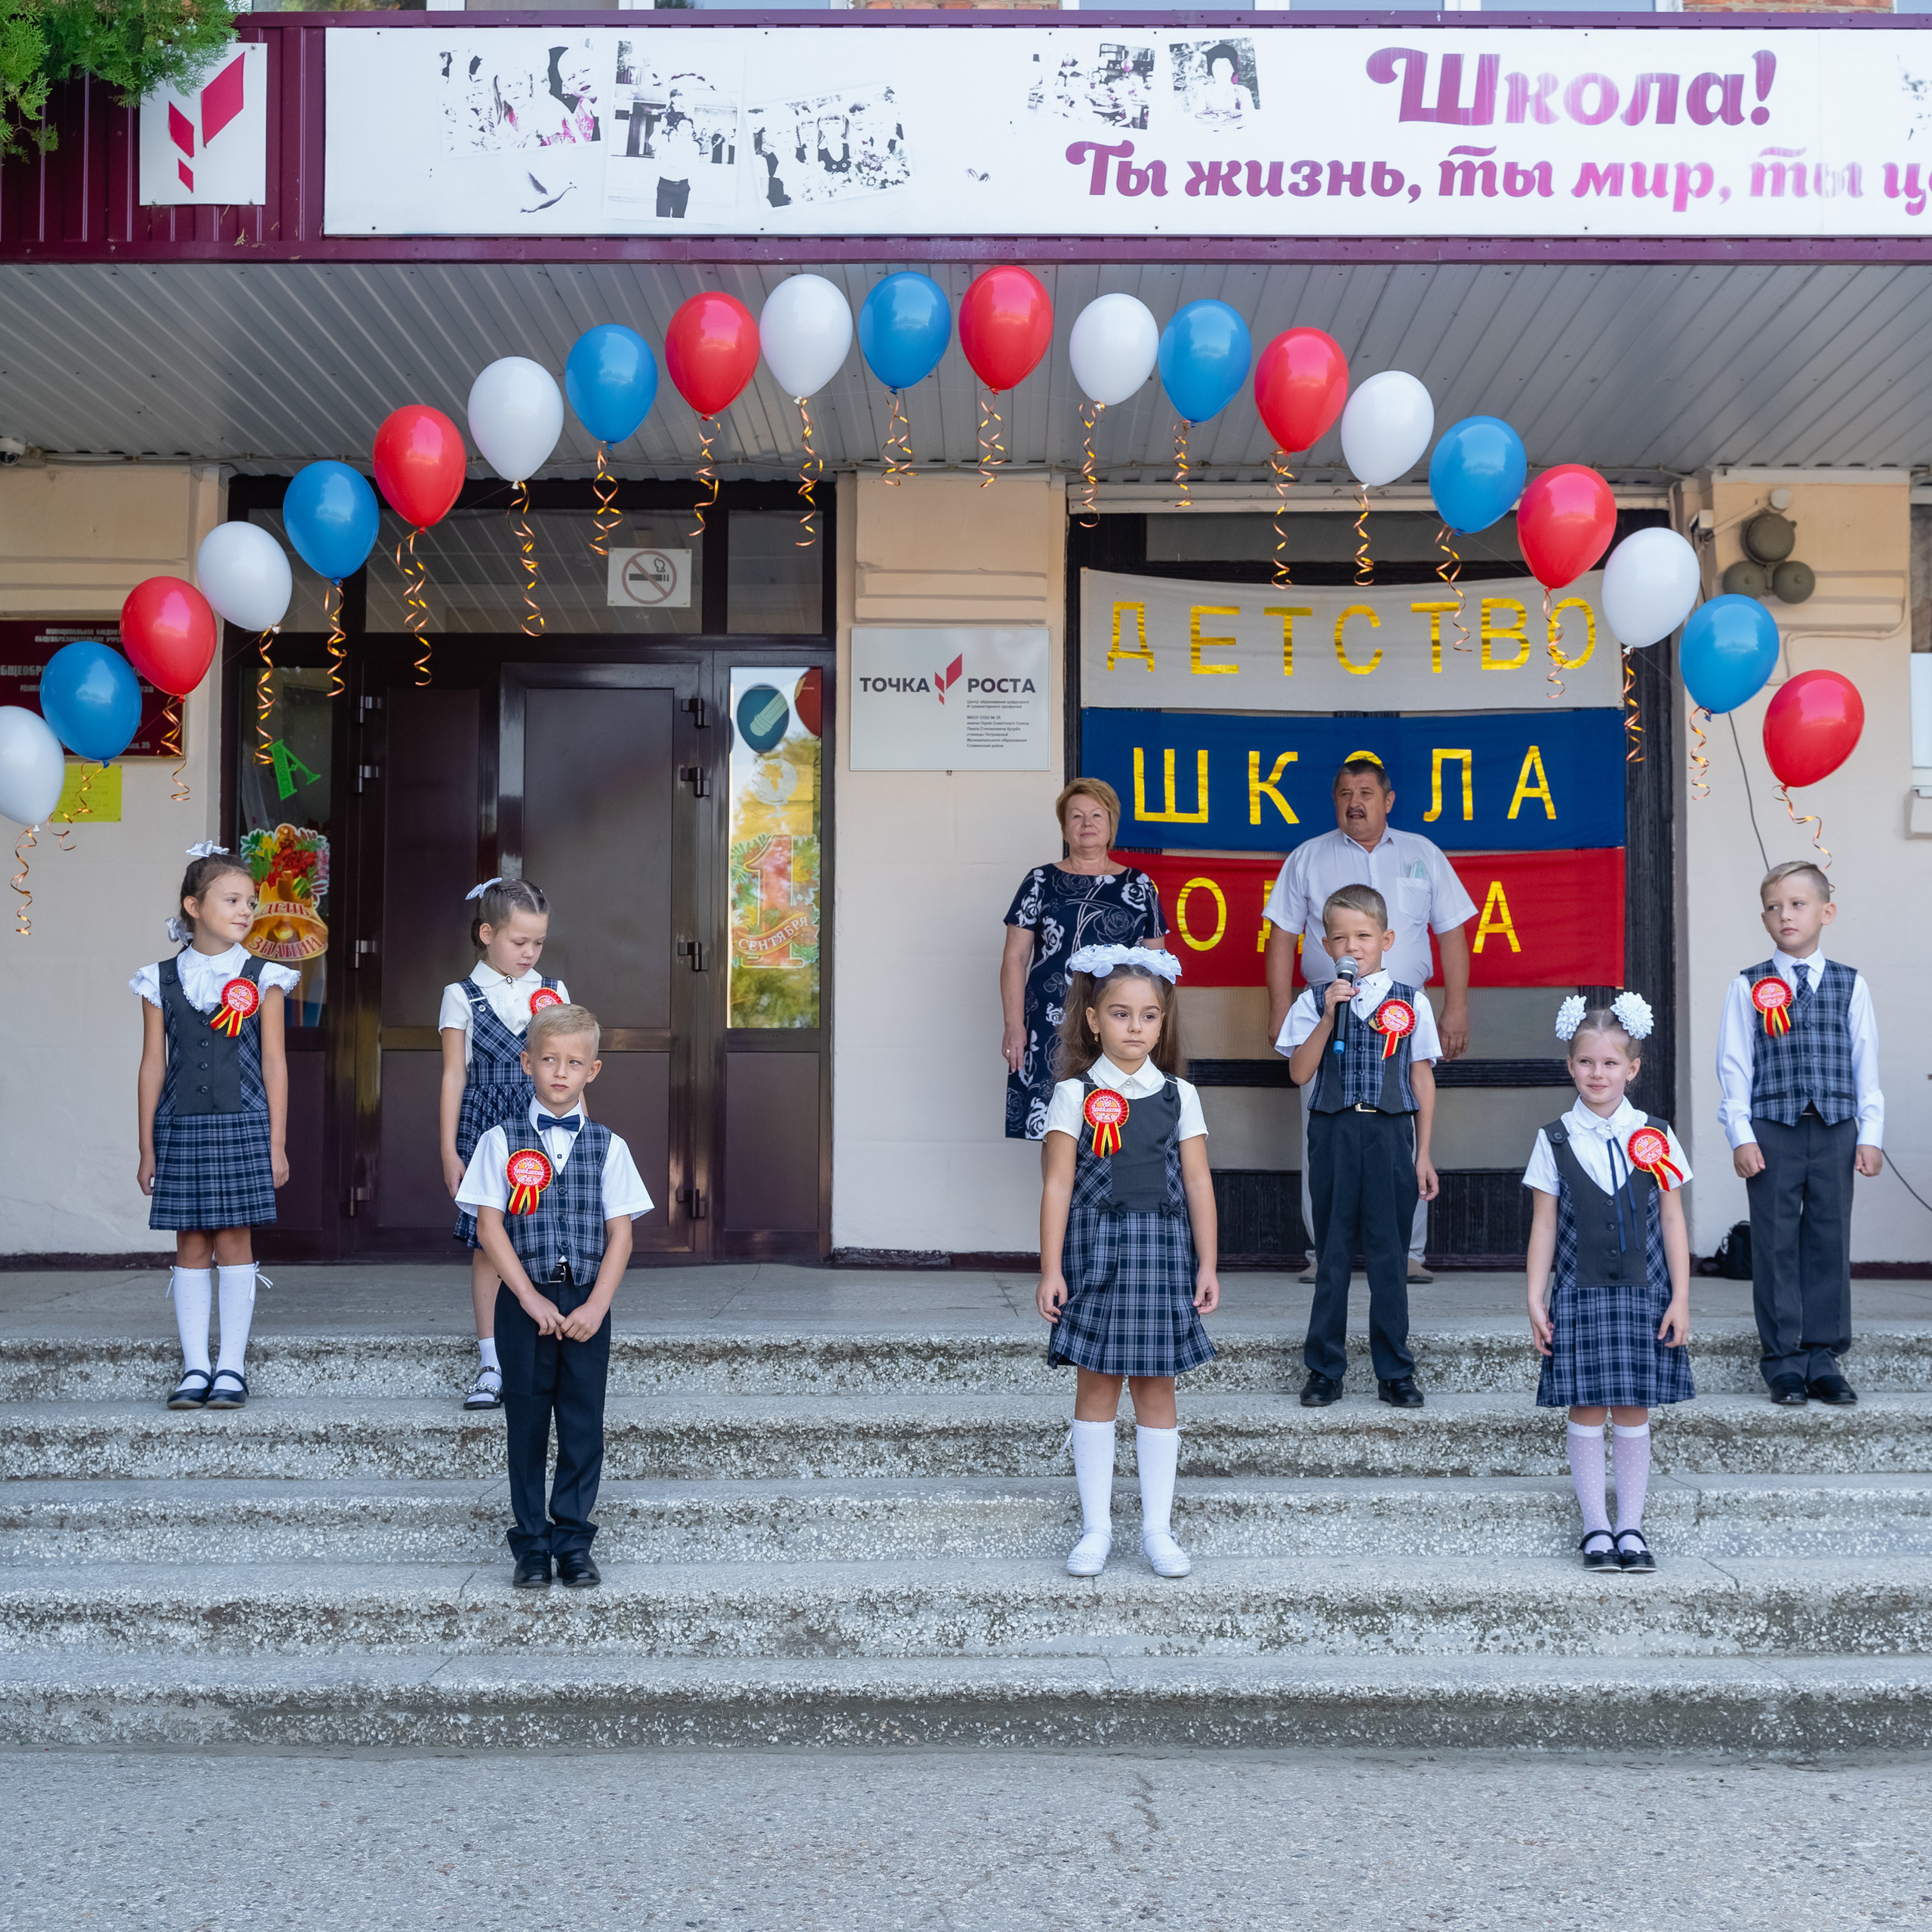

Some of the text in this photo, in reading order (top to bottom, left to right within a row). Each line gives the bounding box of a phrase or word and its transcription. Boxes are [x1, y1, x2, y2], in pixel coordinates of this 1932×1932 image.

[1366, 47, 1777, 125] Школа!
[1066, 140, 1932, 216] Ты жизнь, ты мир, ты ц
[1107, 597, 1595, 676] ДЕТСТВО
[860, 678, 1035, 693] ТОЧКА РОСТА
[1134, 746, 1557, 824] ШКЛА
[260, 902, 310, 916] ДЕНЬ
[738, 915, 810, 952] СЕНТЯБРЯ
[248, 936, 324, 958] ЗНАНИЙ
